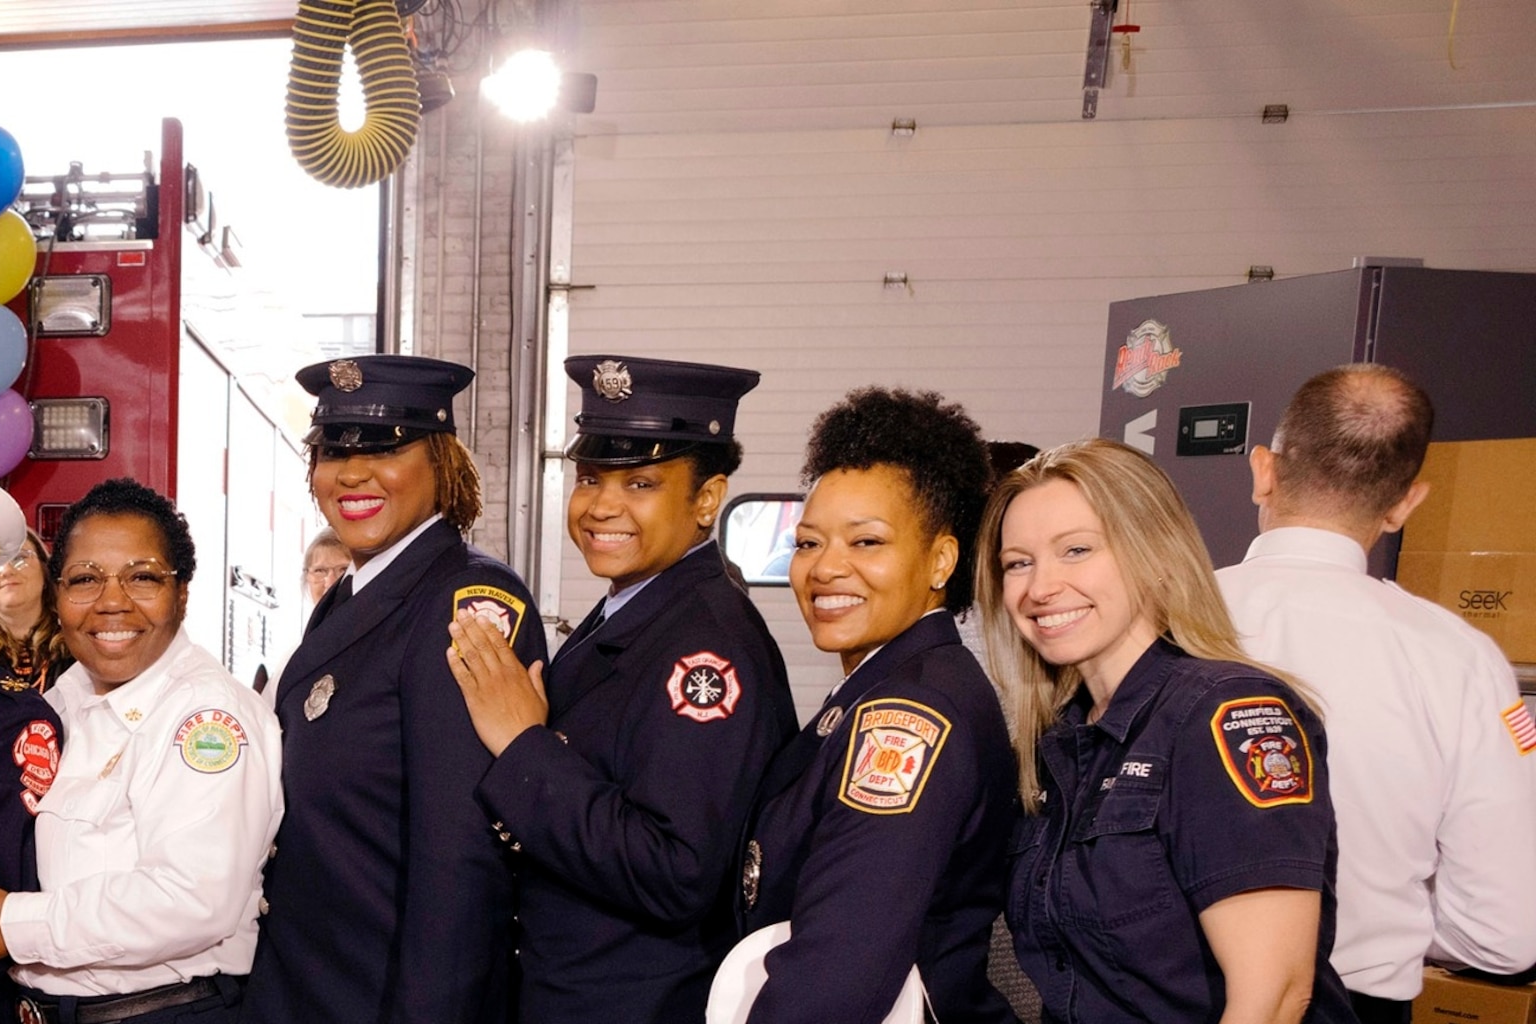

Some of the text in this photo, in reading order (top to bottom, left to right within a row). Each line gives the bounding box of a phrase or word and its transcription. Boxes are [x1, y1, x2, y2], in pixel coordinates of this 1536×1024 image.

[467, 588, 486, 597] NEW
[1463, 611, 1500, 619] thermal
[1231, 707, 1283, 719] FAIRFIELD
[177, 713, 205, 742] FIRE
[863, 711, 938, 741] BRIDGEPORT
[1223, 717, 1293, 731] CONNECTICUT
[33, 725, 50, 737] FIRE
[884, 735, 906, 747] FIRE
[1260, 741, 1283, 751] FIRE
[877, 749, 901, 772] BFD
[1120, 761, 1152, 777] FIRE
[868, 774, 894, 787] DEPT
[850, 788, 904, 805] CONNECTICUT
